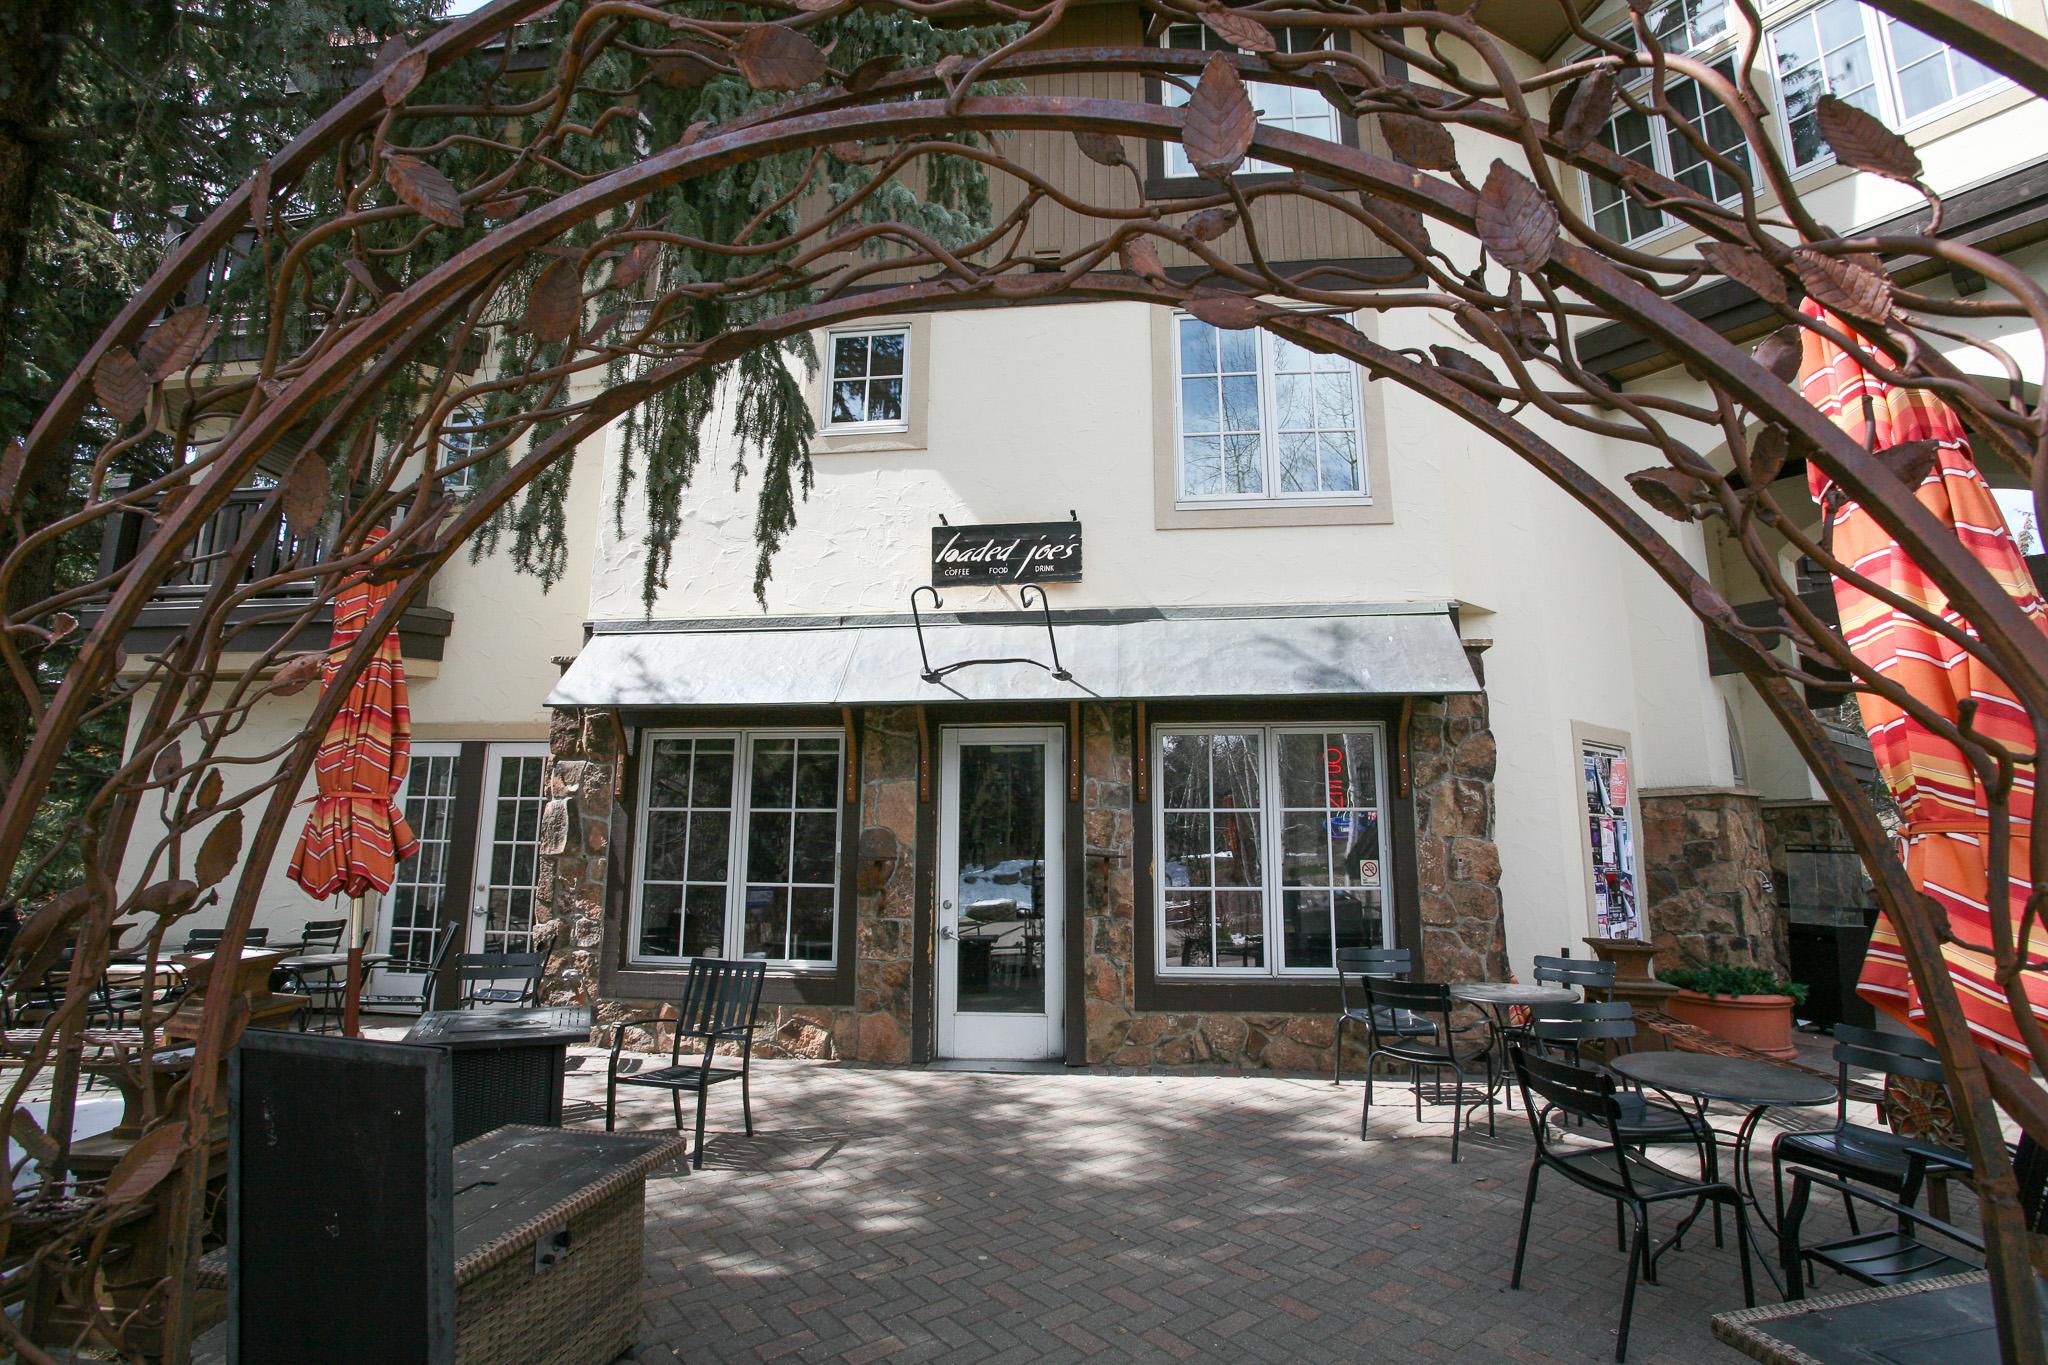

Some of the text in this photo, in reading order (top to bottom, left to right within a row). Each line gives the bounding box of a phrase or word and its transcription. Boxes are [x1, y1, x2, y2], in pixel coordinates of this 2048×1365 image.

[935, 532, 1079, 579] loaded joe's
[944, 568, 970, 576] COFFEE
